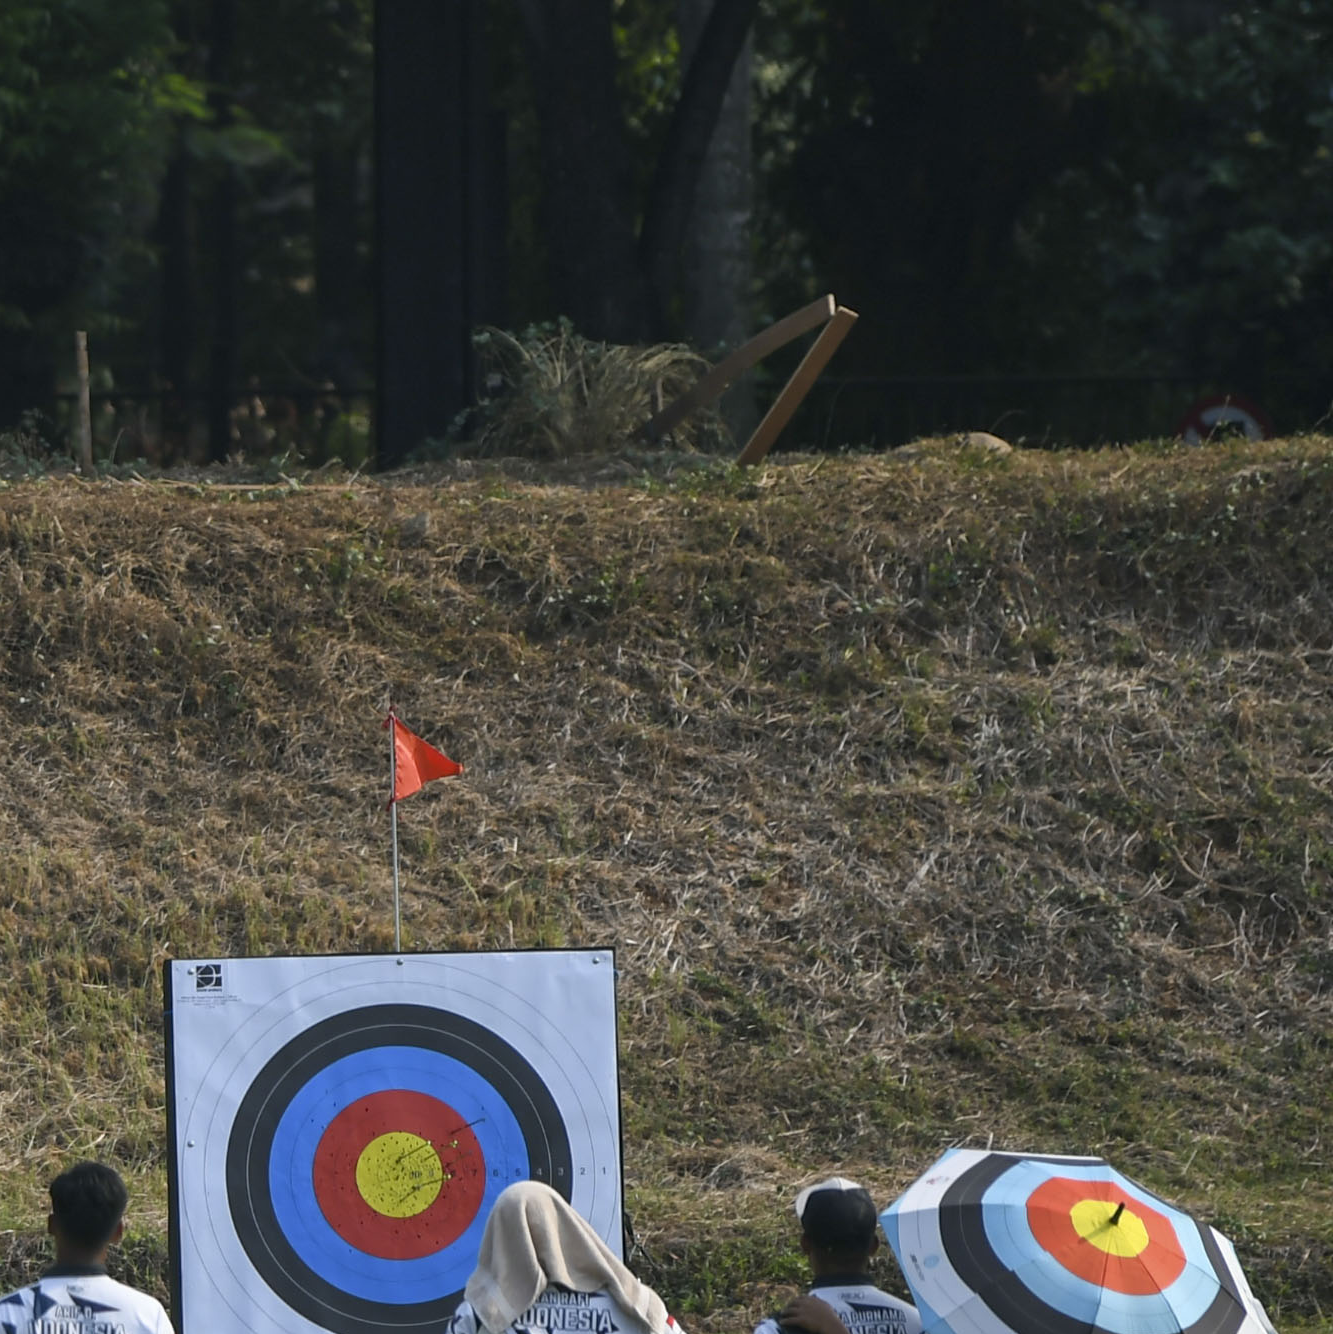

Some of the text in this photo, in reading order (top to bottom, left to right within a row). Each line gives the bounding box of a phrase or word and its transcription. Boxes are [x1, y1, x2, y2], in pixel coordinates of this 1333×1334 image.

[515, 1168, 521, 1177] 5
[536, 1168, 543, 1176] 4
[557, 1167, 564, 1176] 3
[580, 1167, 586, 1175] 2
[602, 1166, 606, 1175] 1
[515, 1306, 613, 1333] DONESIA
